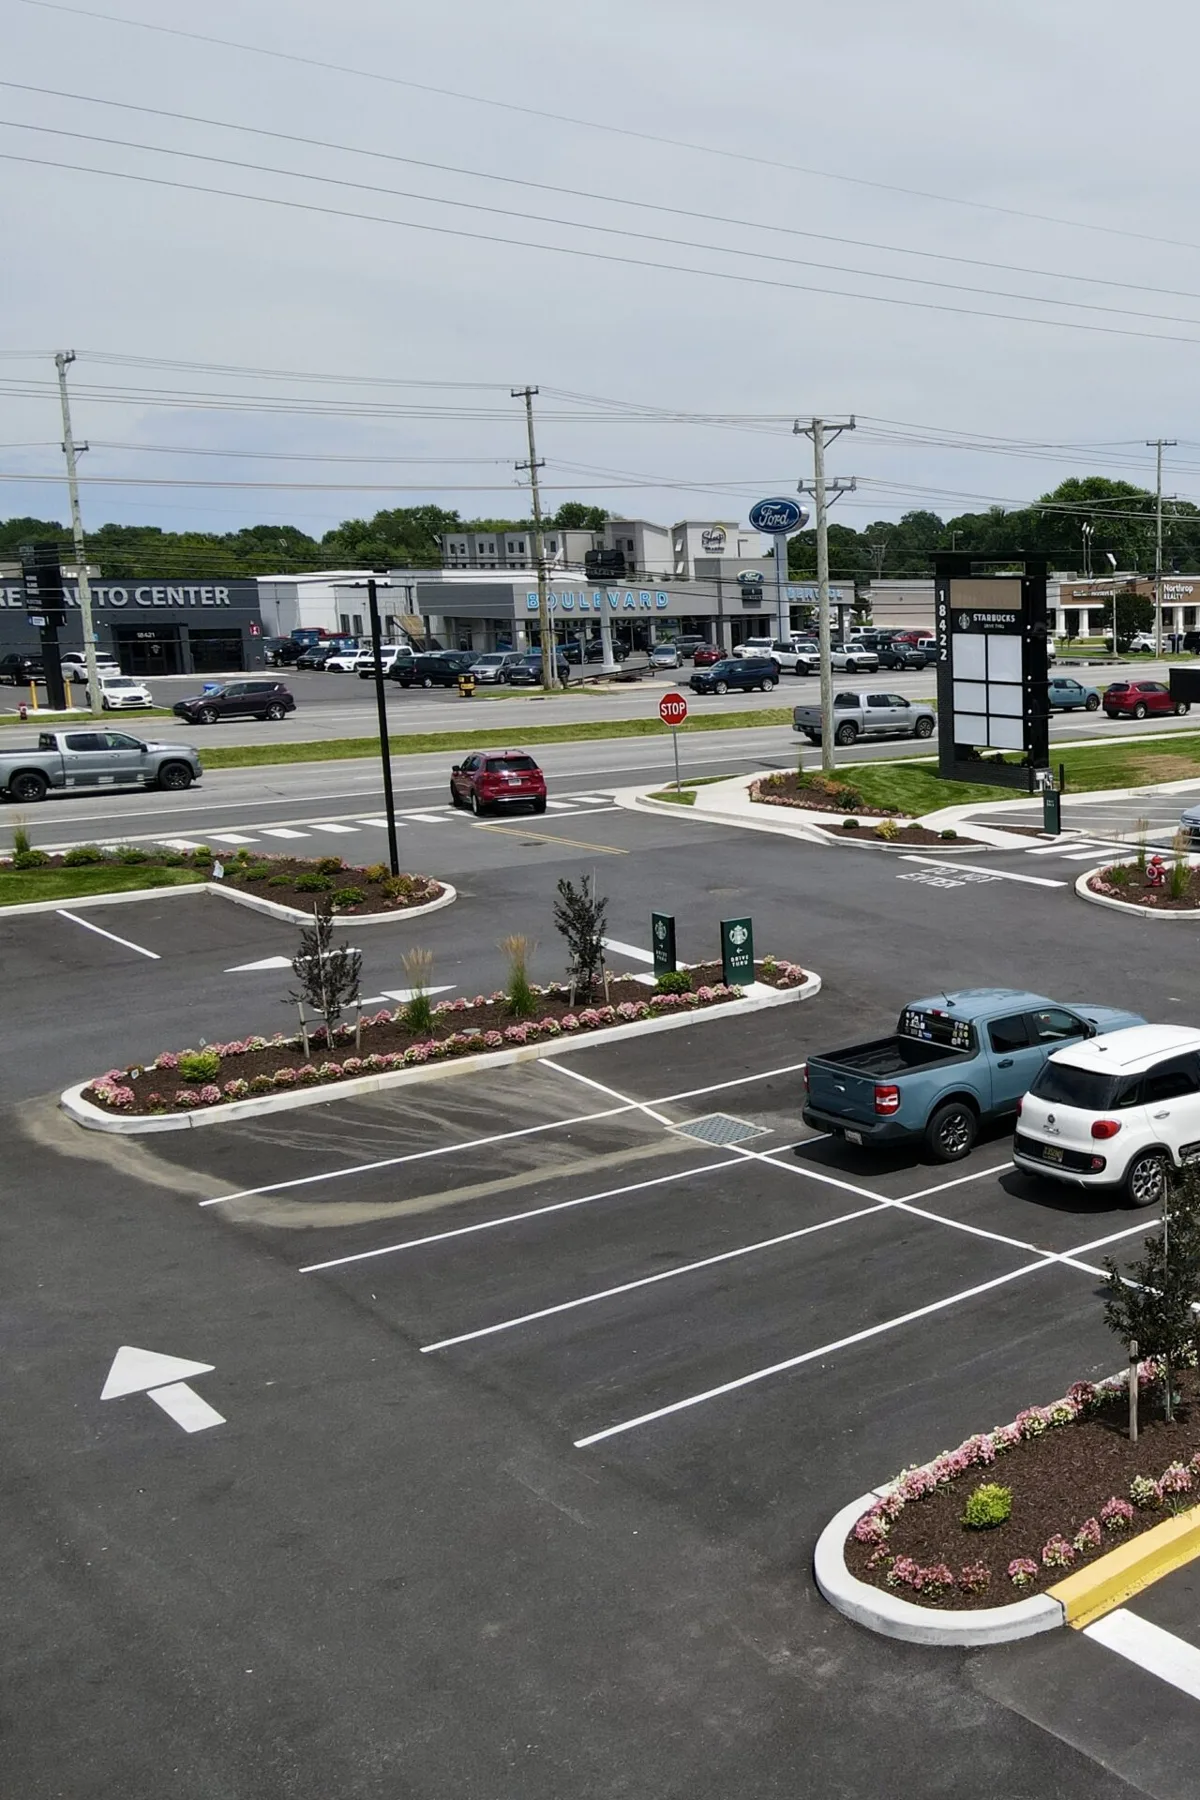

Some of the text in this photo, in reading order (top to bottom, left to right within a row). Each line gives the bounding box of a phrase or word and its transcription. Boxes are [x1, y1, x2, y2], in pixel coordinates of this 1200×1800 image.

[759, 504, 791, 527] Ford
[1163, 583, 1194, 594] Northrop
[134, 586, 230, 606] CENTER
[972, 613, 1016, 623] STARBUCKS
[939, 590, 948, 661] 18422
[660, 702, 686, 716] STOP
[730, 954, 749, 962] DRIVE
[732, 960, 749, 968] THRU
